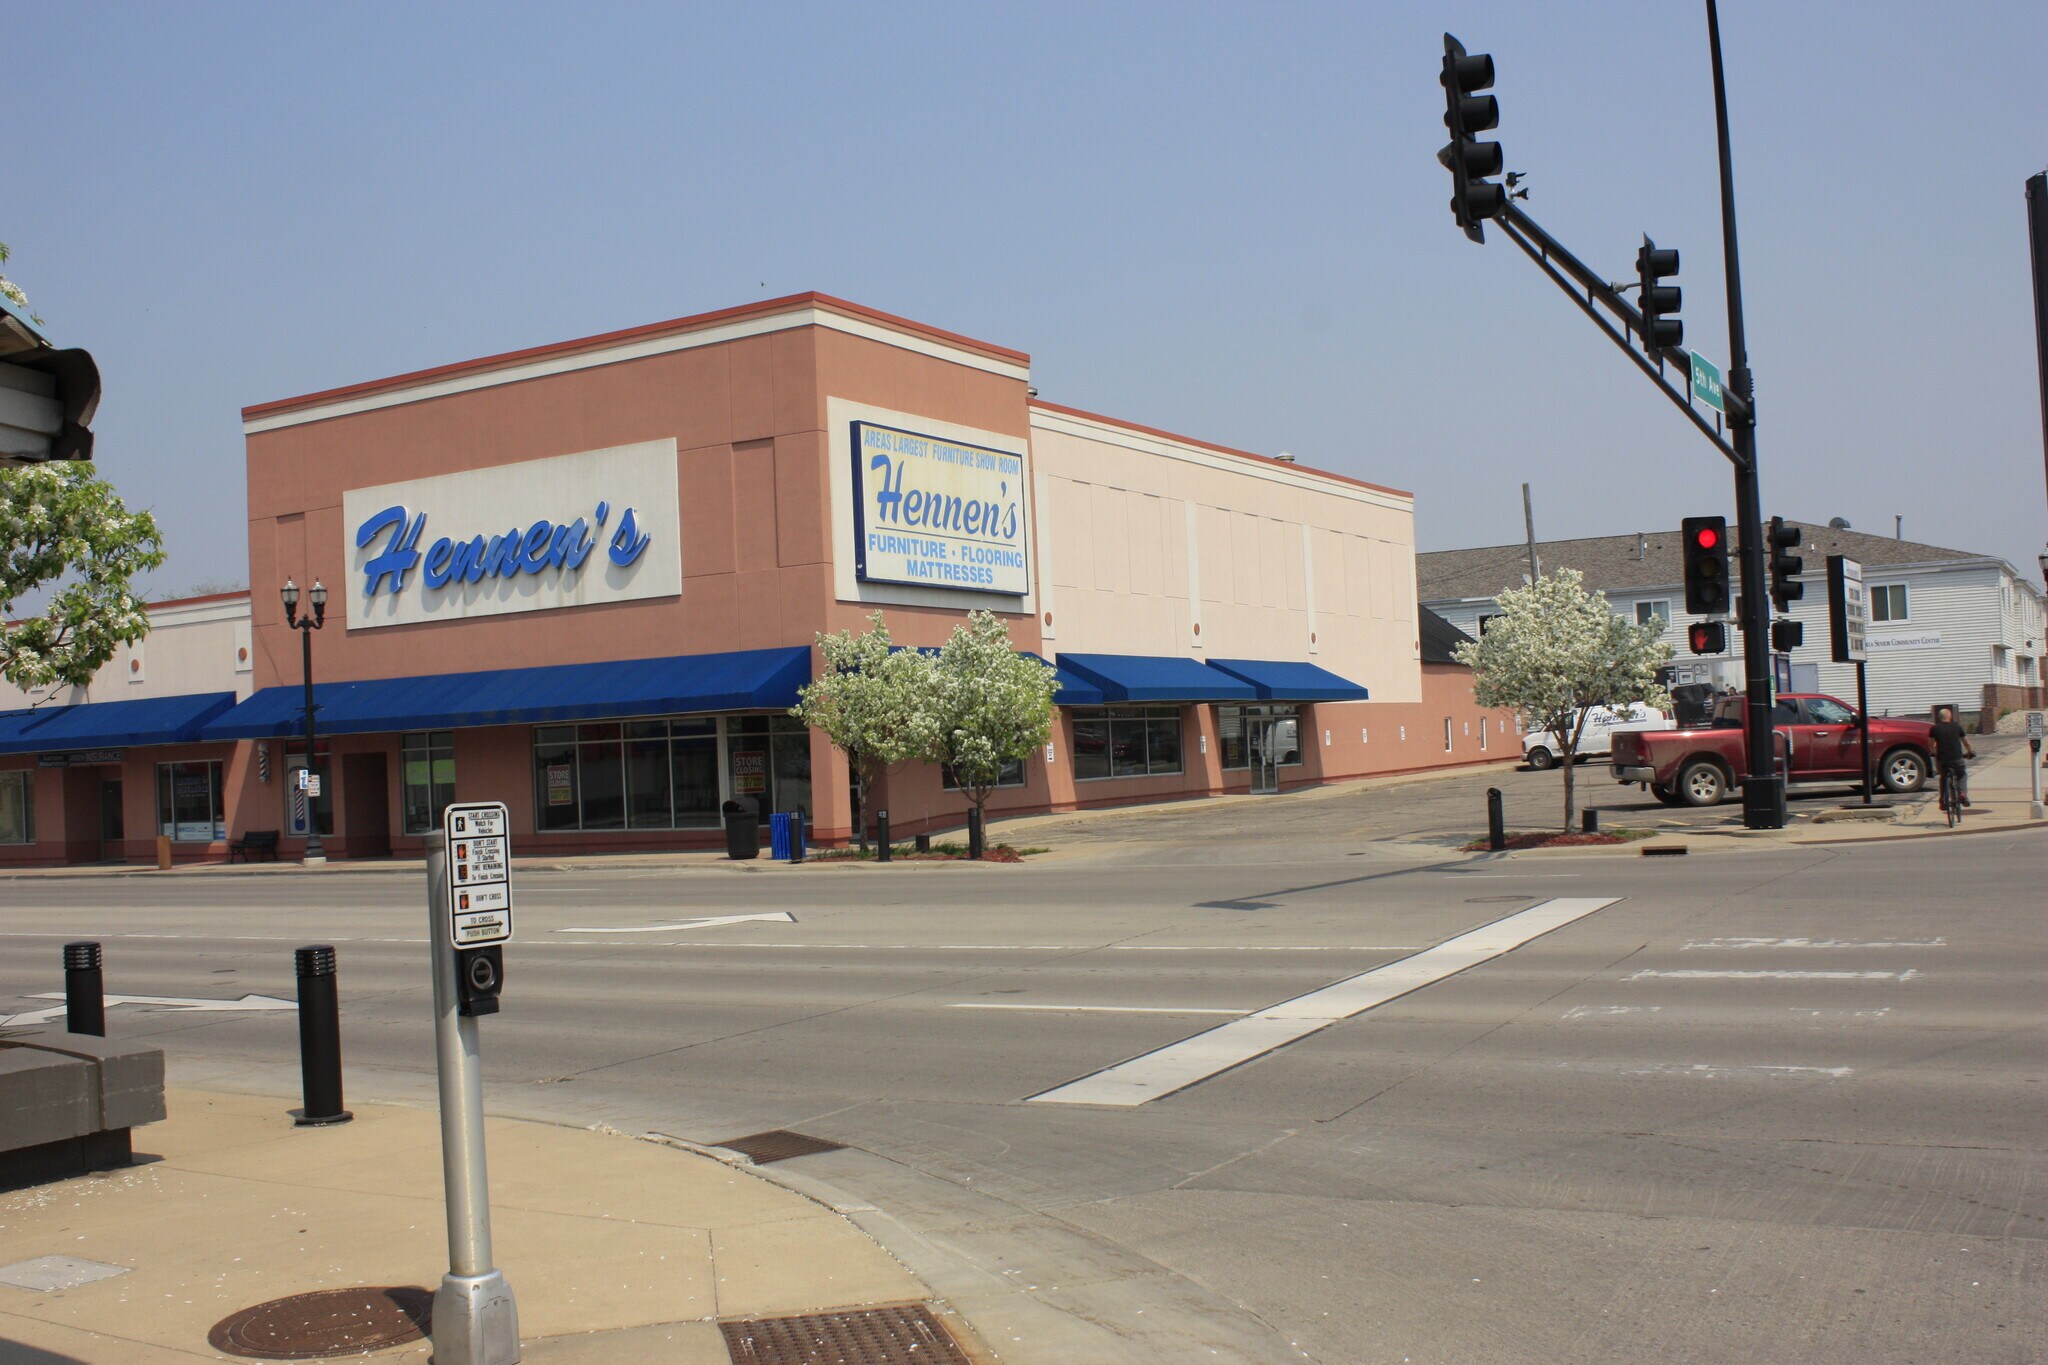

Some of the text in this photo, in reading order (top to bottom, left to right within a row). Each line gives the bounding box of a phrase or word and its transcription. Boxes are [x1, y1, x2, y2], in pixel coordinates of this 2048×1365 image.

[864, 429, 1019, 475] AREAS LARGEST FURNITURE SHOW ROOM
[870, 454, 1017, 540] Hennen's
[355, 500, 651, 596] Hennen's
[868, 533, 1023, 568] FURNITURE FLOORING
[907, 559, 993, 584] MATTRESSES
[1891, 638, 1921, 647] COMMUNITY
[1921, 637, 1940, 645] CENTER
[736, 757, 763, 766] STORE
[549, 770, 570, 779] STORE
[736, 766, 764, 774] CLOSING
[481, 810, 501, 818] CROSSING
[482, 862, 503, 870] REMAINING
[475, 894, 488, 902] DON'T
[478, 915, 494, 923] CROSS
